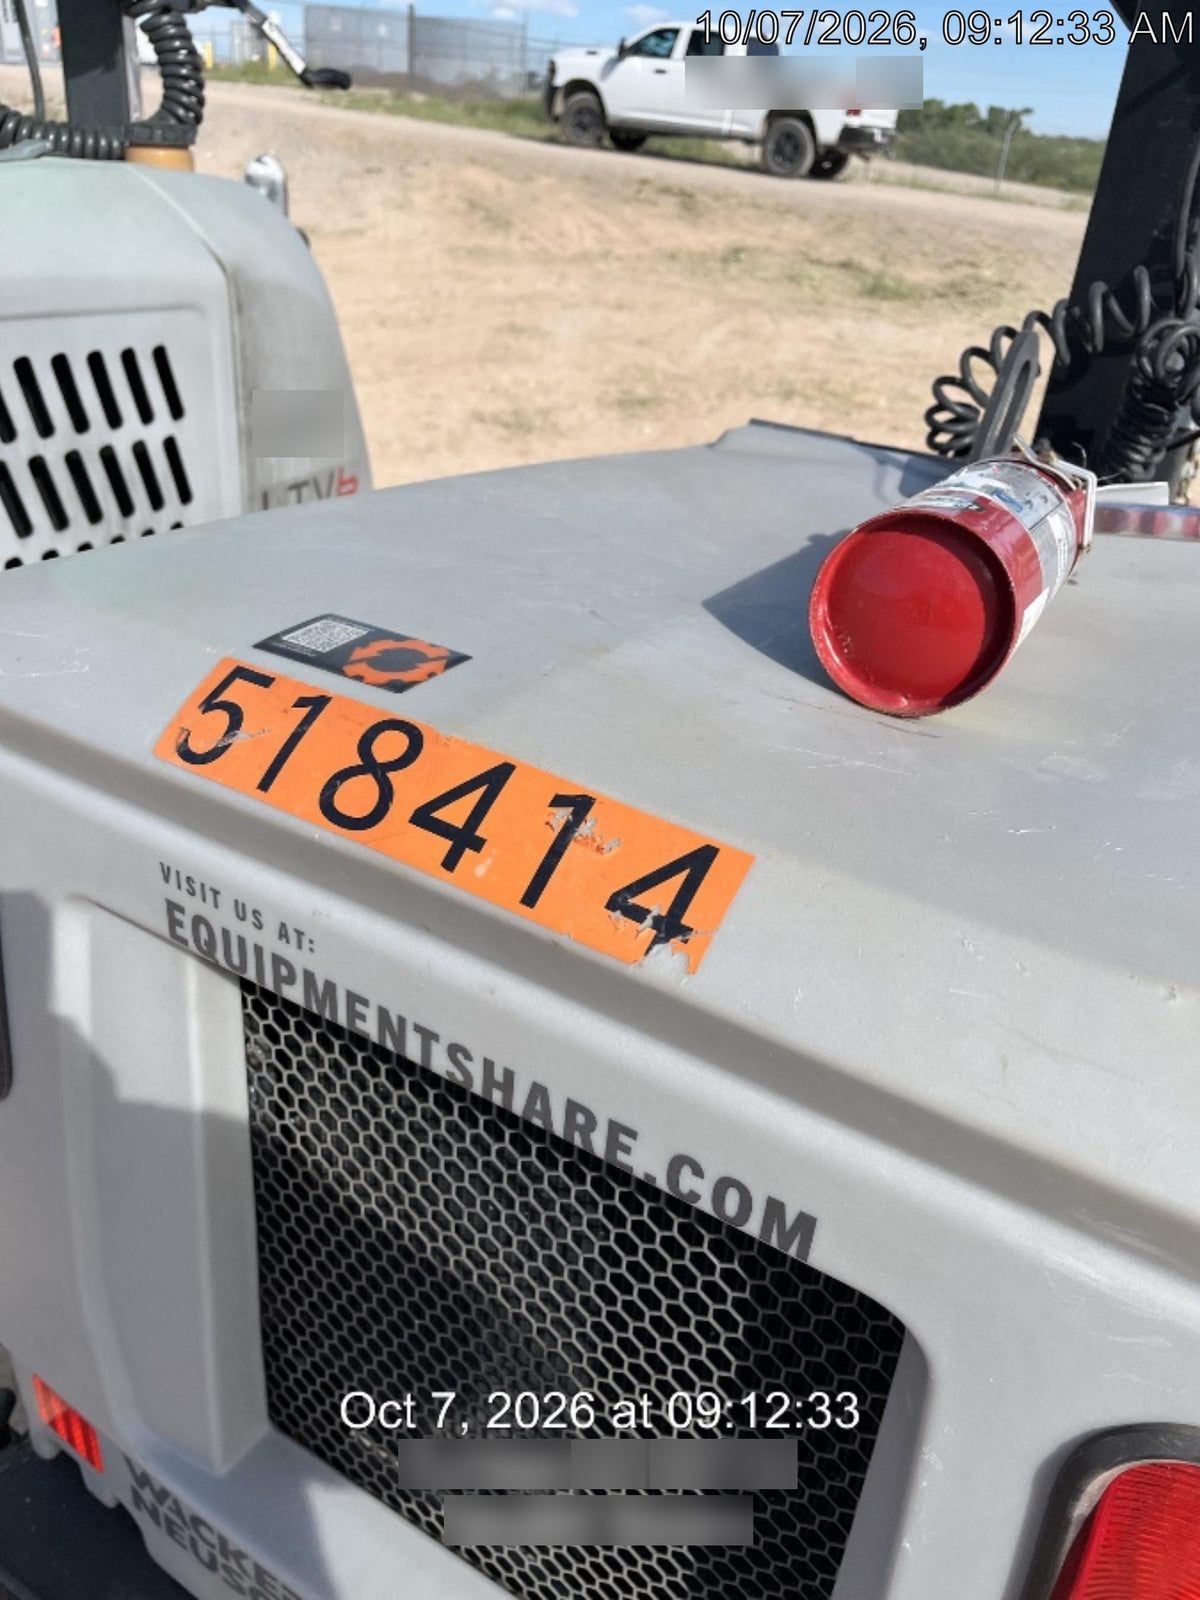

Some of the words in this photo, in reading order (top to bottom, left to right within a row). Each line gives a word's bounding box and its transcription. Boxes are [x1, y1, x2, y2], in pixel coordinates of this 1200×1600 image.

[159, 862, 221, 910] VISIT
[234, 898, 264, 931] US
[278, 921, 315, 954] AT:
[176, 665, 720, 958] 518414
[165, 898, 818, 1262] EQUIPMENTSHARE.COM
[130, 1484, 274, 1600] NEUS
